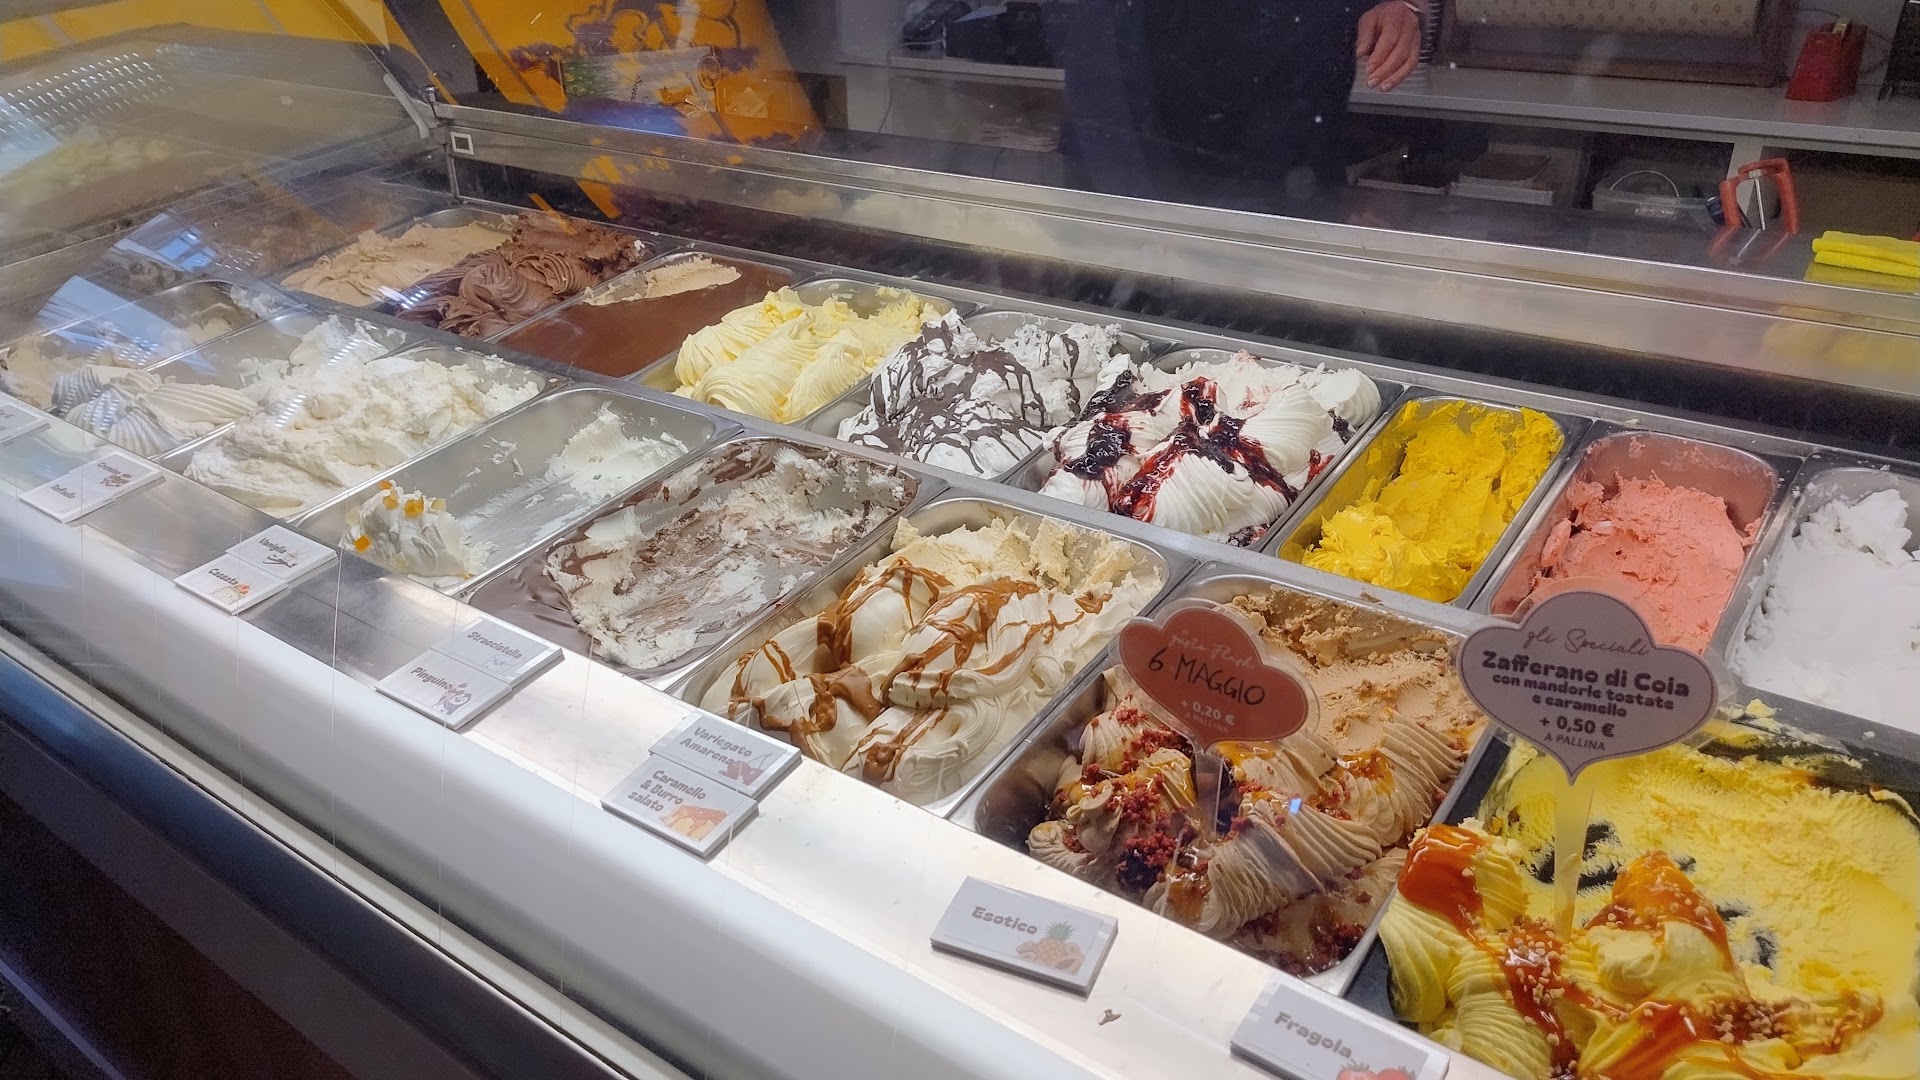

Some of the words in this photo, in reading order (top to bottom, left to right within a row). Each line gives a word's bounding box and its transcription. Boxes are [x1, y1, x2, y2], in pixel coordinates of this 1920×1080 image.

[259, 537, 287, 554] Vaniglia
[208, 568, 238, 585] Cassata
[467, 631, 522, 659] Stracciatella
[1523, 626, 1556, 649] gli
[1566, 628, 1649, 654] Speciali
[410, 666, 453, 690] Pinguino
[1148, 647, 1167, 671] 6
[1174, 653, 1265, 705] MAGGIO
[1482, 650, 1598, 684] Zafferano
[1605, 668, 1628, 688] di
[1634, 672, 1690, 698] Coia
[1492, 673, 1520, 687] con
[1524, 676, 1602, 699] mandorle
[1606, 688, 1674, 710] tostate
[1192, 700, 1221, 720] 0,20
[1225, 714, 1236, 726] €
[1532, 694, 1542, 704] e
[1545, 695, 1627, 718] caramello
[1556, 715, 1596, 735] 0,50
[1601, 722, 1615, 738] €
[679, 737, 736, 765] Amarena
[693, 726, 753, 757] Variegato
[1544, 732, 1552, 741] A
[1556, 734, 1606, 751] PALLINA
[640, 779, 652, 790] &
[650, 783, 684, 805] Burro
[652, 770, 707, 800] Caramello
[627, 791, 664, 812] salato
[971, 905, 1038, 935] Esotico
[1274, 1011, 1352, 1059] Fragola
